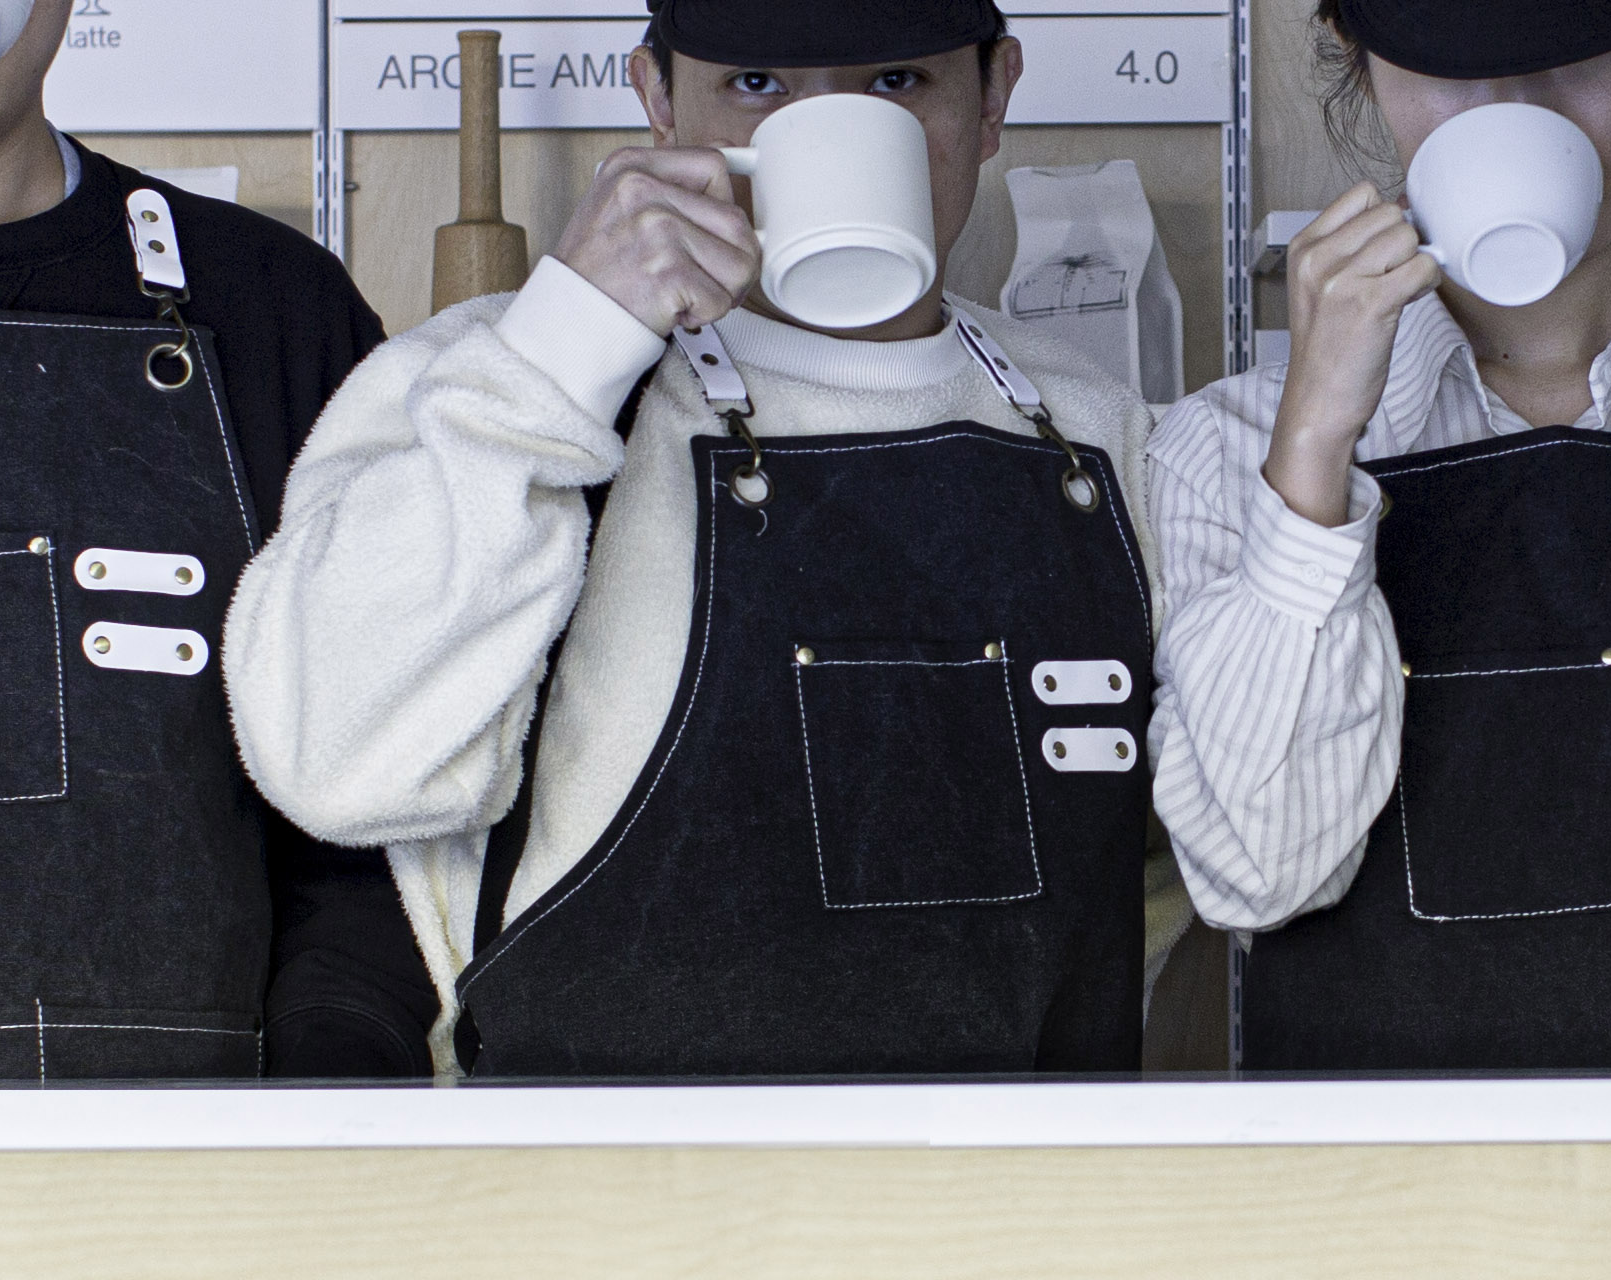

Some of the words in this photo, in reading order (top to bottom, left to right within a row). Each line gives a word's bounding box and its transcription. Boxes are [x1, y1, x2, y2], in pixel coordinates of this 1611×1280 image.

[66, 26, 121, 49] latte
[378, 53, 536, 89] ARCE
[1115, 49, 1179, 85] 4.0
